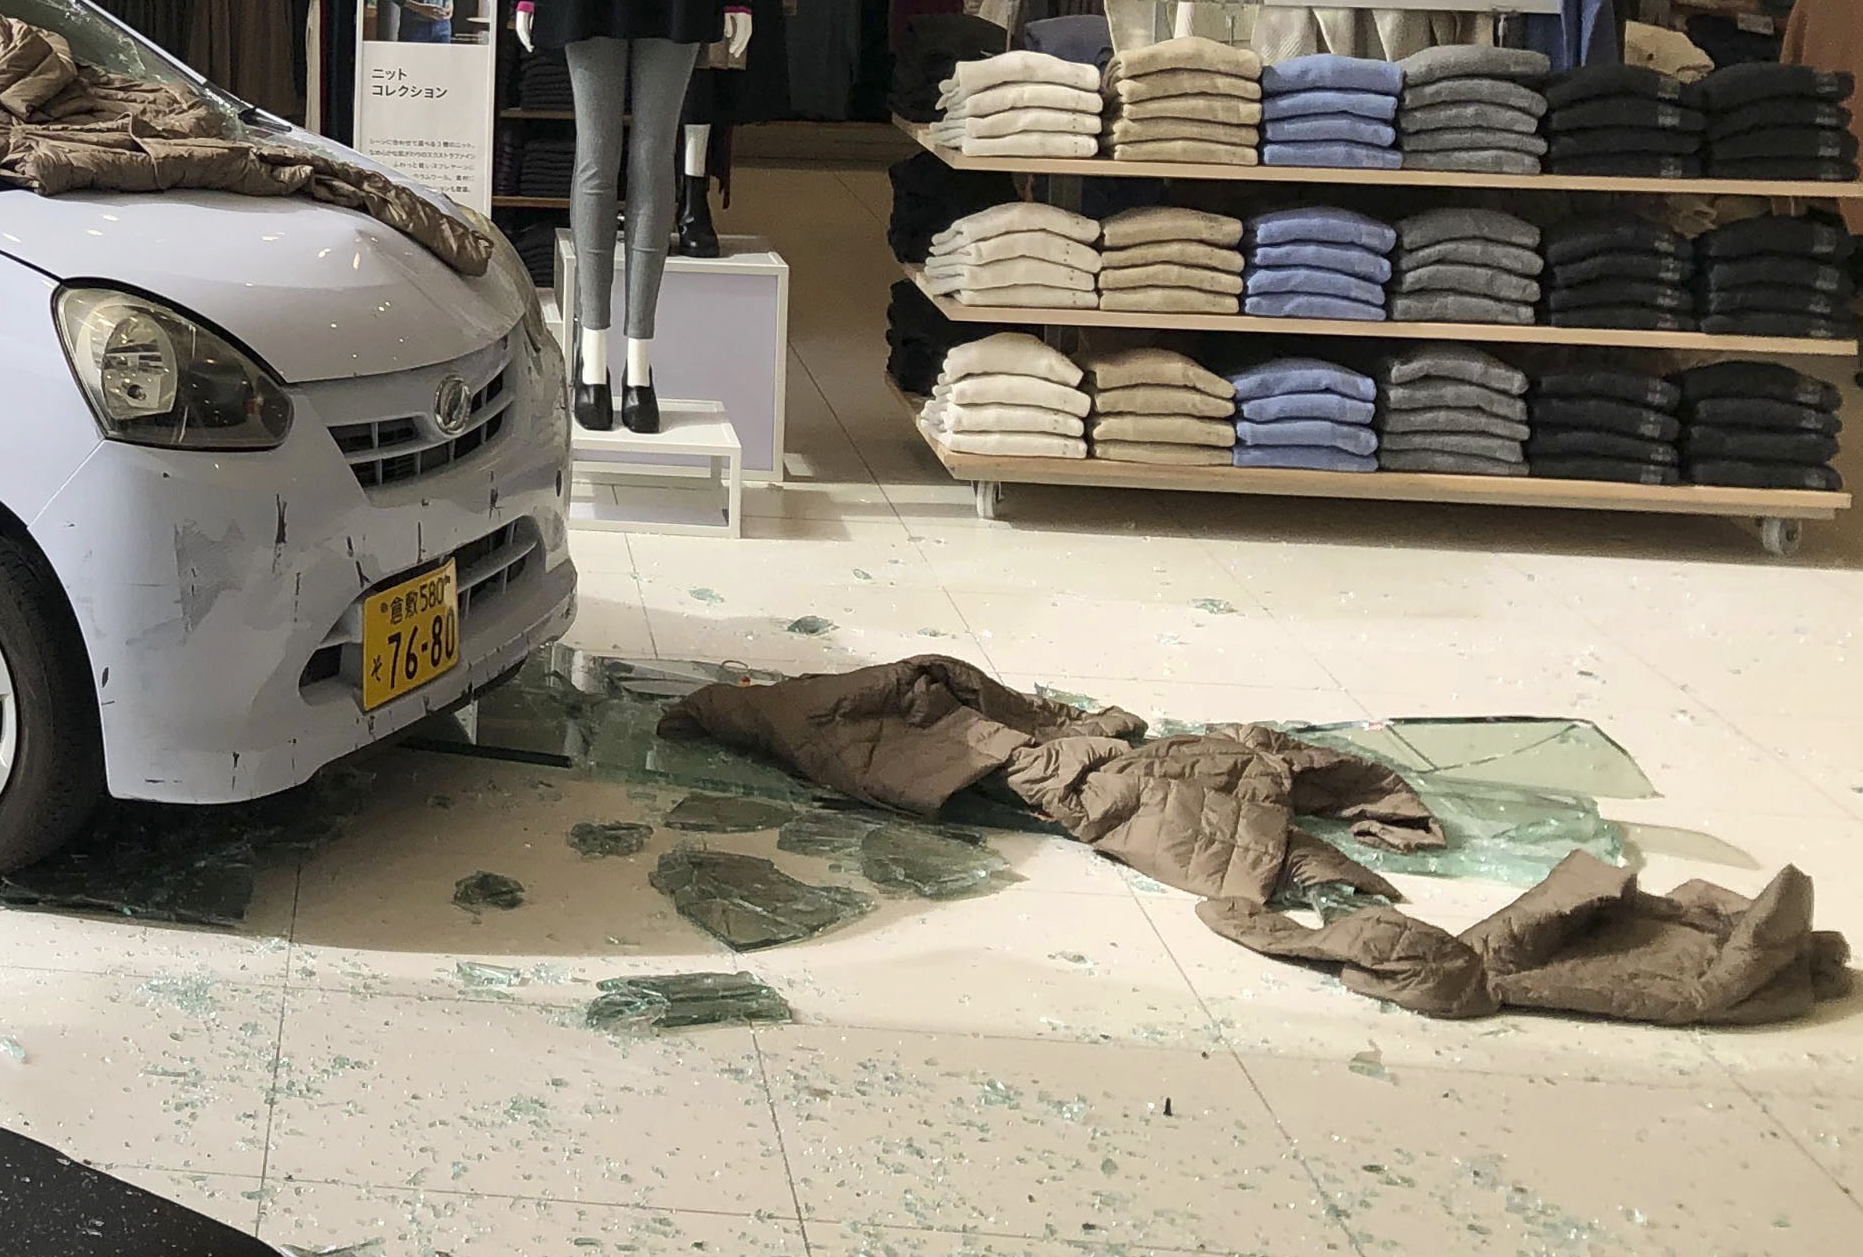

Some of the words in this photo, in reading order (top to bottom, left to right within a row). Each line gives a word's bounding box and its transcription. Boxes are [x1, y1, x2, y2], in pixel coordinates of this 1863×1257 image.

[371, 67, 408, 81] ニット
[371, 84, 448, 99] コレクション
[390, 589, 418, 625] 倉敷
[419, 576, 445, 612] 580
[387, 606, 456, 689] 76-80
